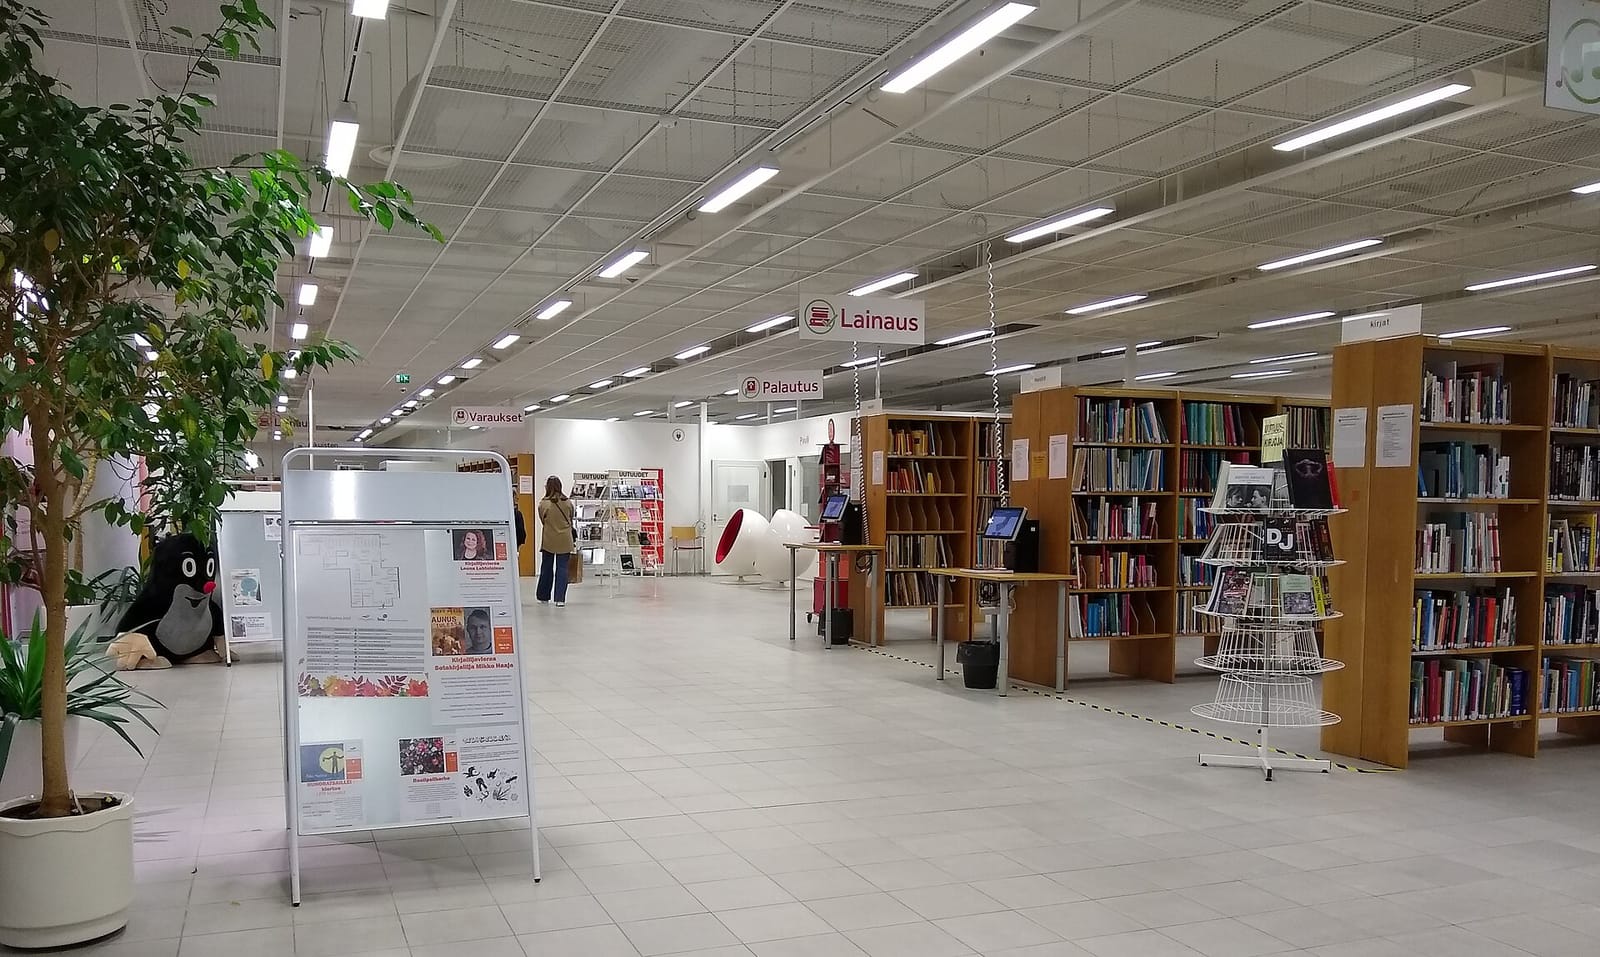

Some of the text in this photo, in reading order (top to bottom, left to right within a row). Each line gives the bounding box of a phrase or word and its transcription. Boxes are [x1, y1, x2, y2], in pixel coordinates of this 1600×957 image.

[841, 308, 918, 332] Lainaus
[1370, 318, 1390, 329] kirjat
[763, 381, 819, 393] Palautus
[469, 412, 523, 422] Varaukset
[1266, 528, 1294, 550] DJ
[431, 615, 457, 623] AUNUS
